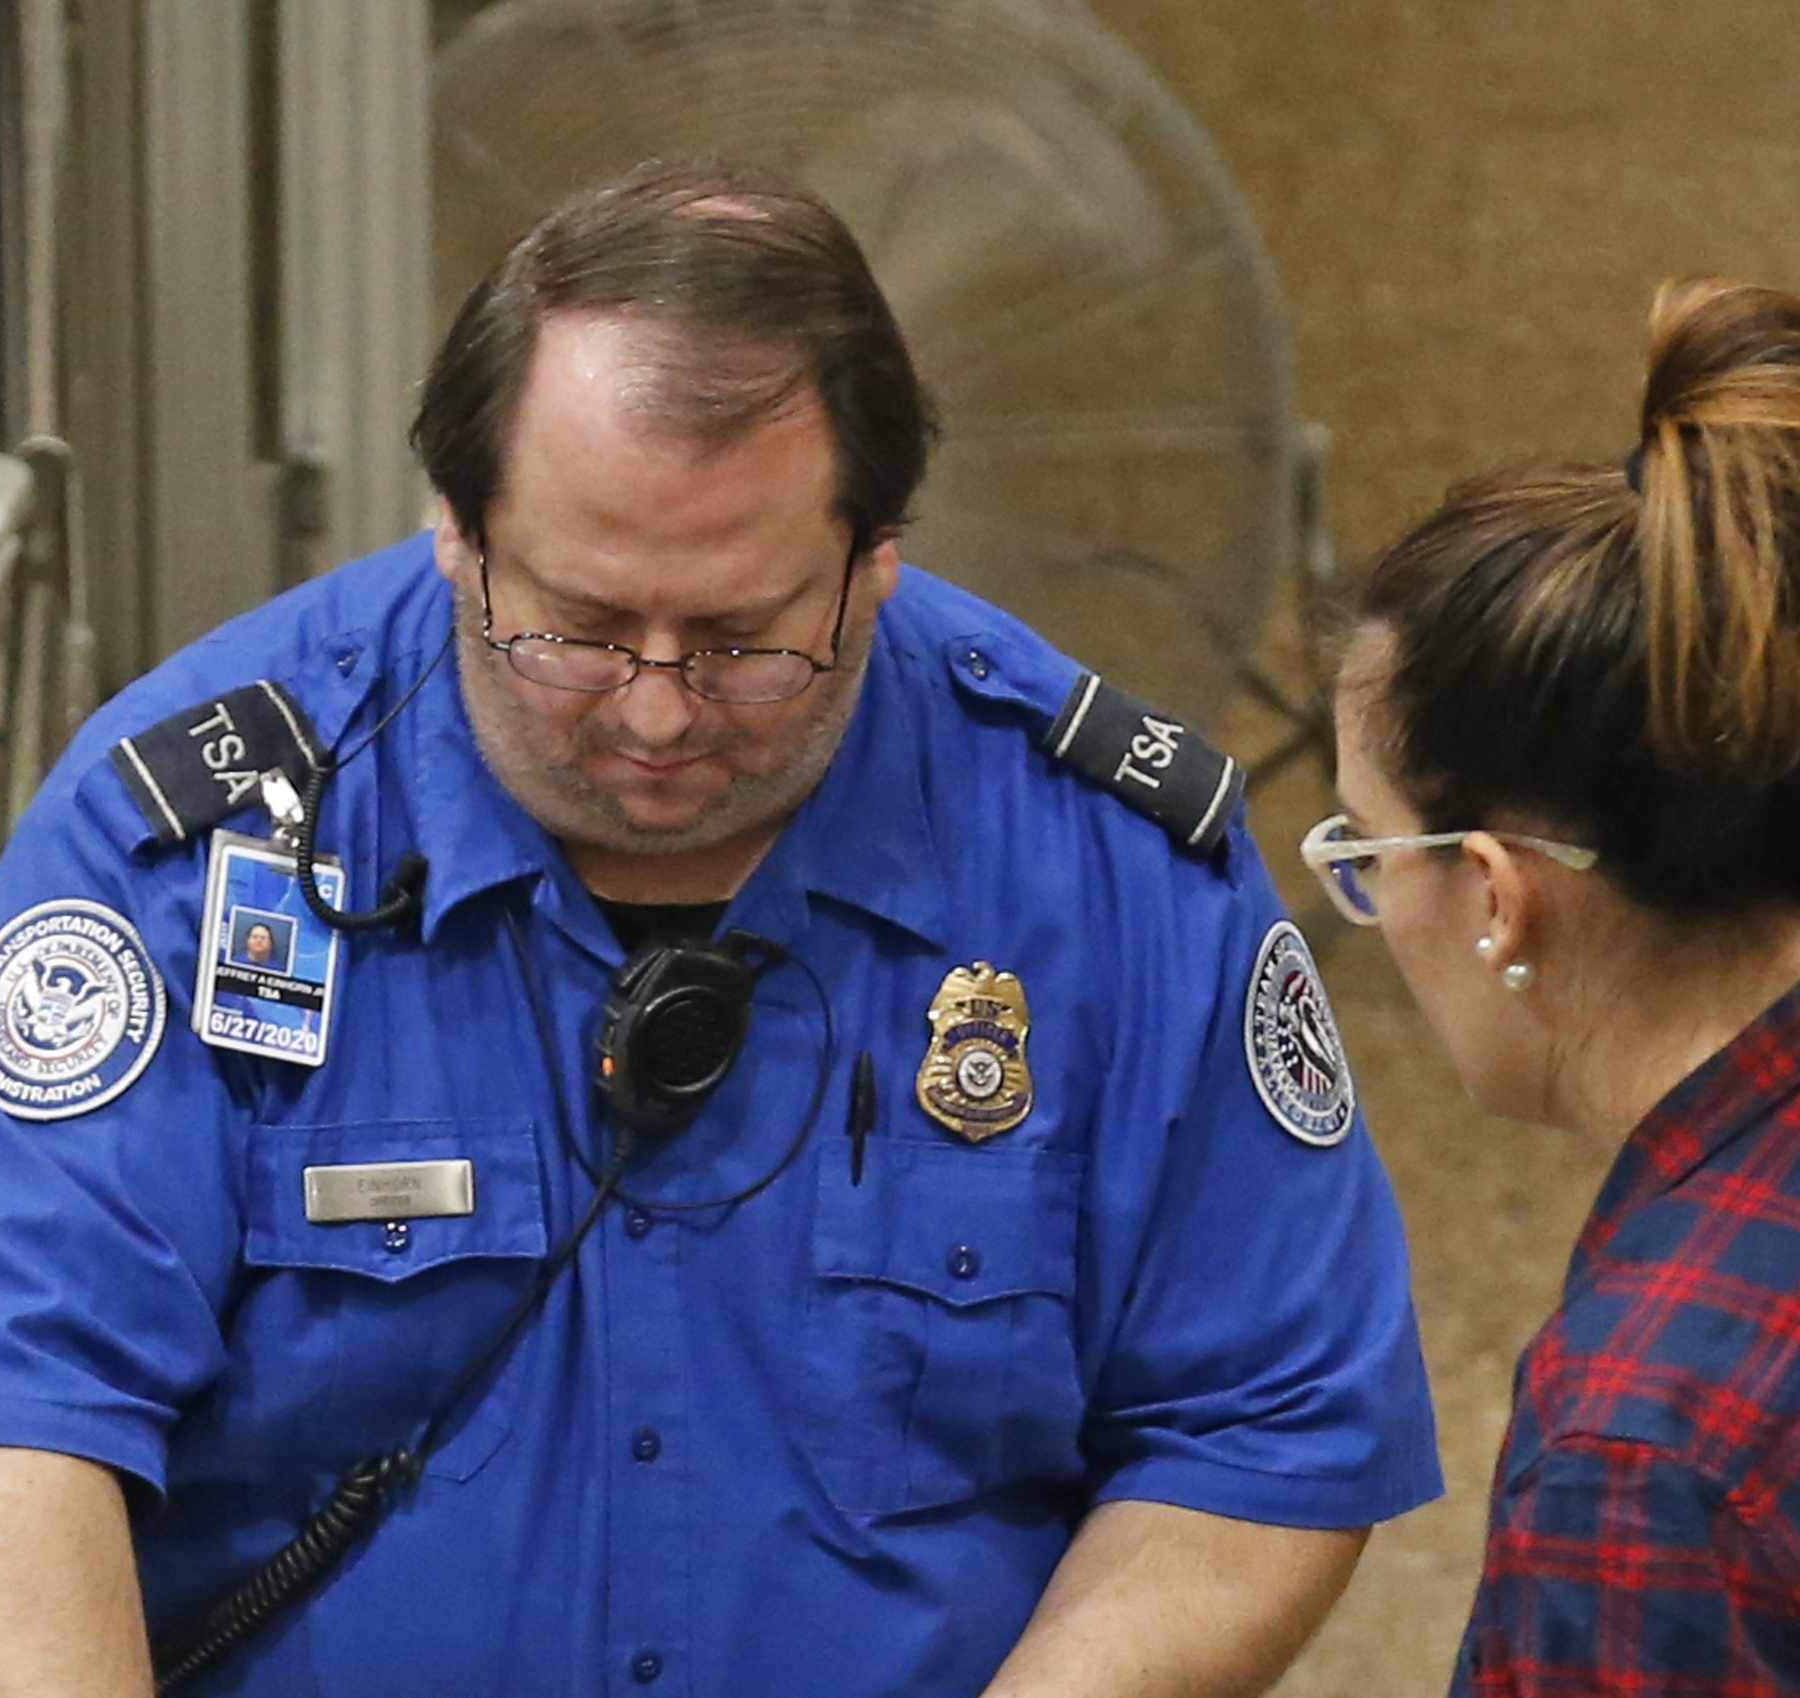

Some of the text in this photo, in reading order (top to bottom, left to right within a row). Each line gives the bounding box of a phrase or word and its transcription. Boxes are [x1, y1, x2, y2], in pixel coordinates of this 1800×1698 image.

[188, 702, 259, 805] TSA
[1113, 715, 1184, 789] TSA
[116, 948, 150, 1045] SECURITY
[210, 1011, 318, 1054] 6/27/2020
